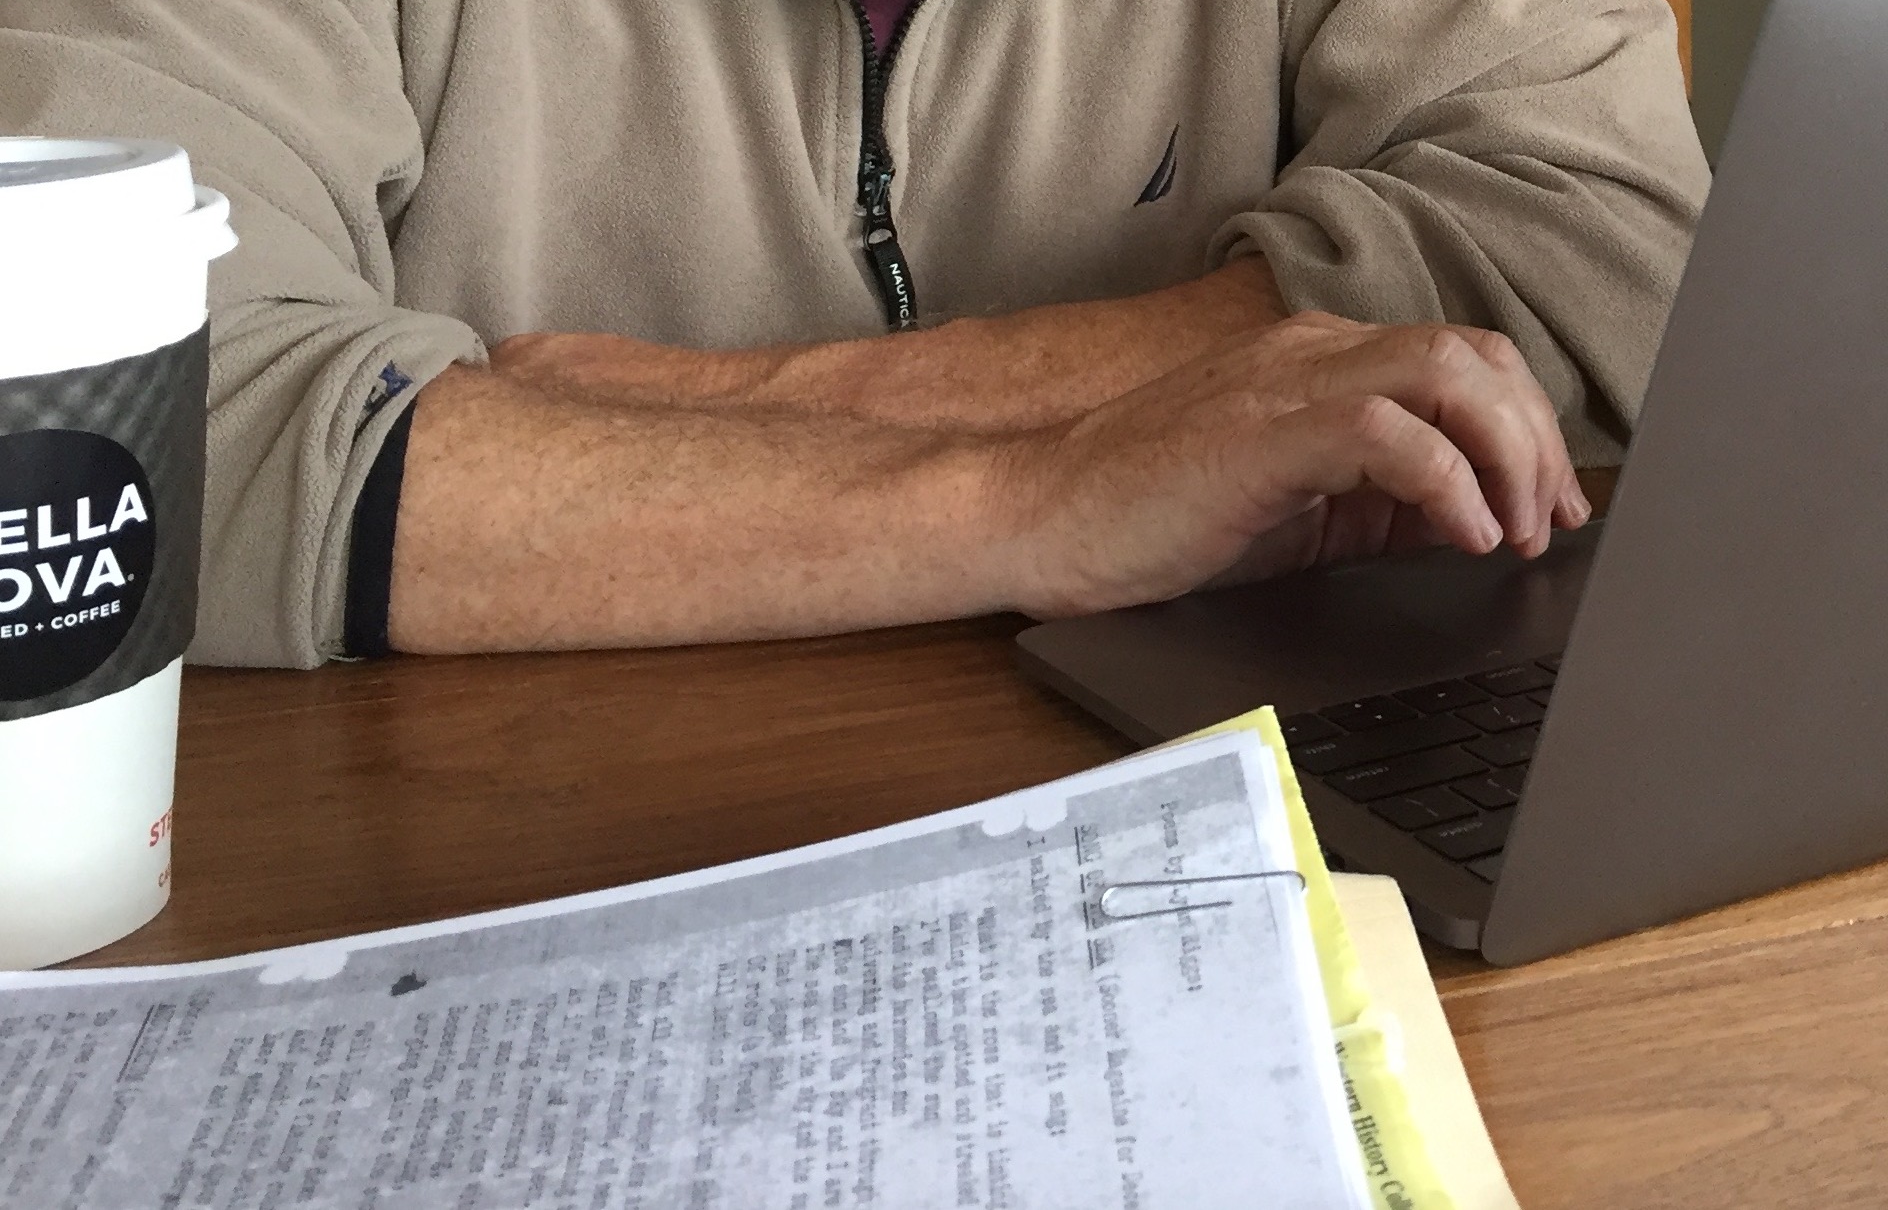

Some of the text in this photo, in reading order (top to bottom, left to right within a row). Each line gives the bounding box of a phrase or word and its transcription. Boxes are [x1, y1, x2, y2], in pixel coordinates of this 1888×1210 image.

[0, 483, 148, 555] ELLA
[51, 600, 121, 630] COFFEE
[1352, 1114, 1390, 1178] History
